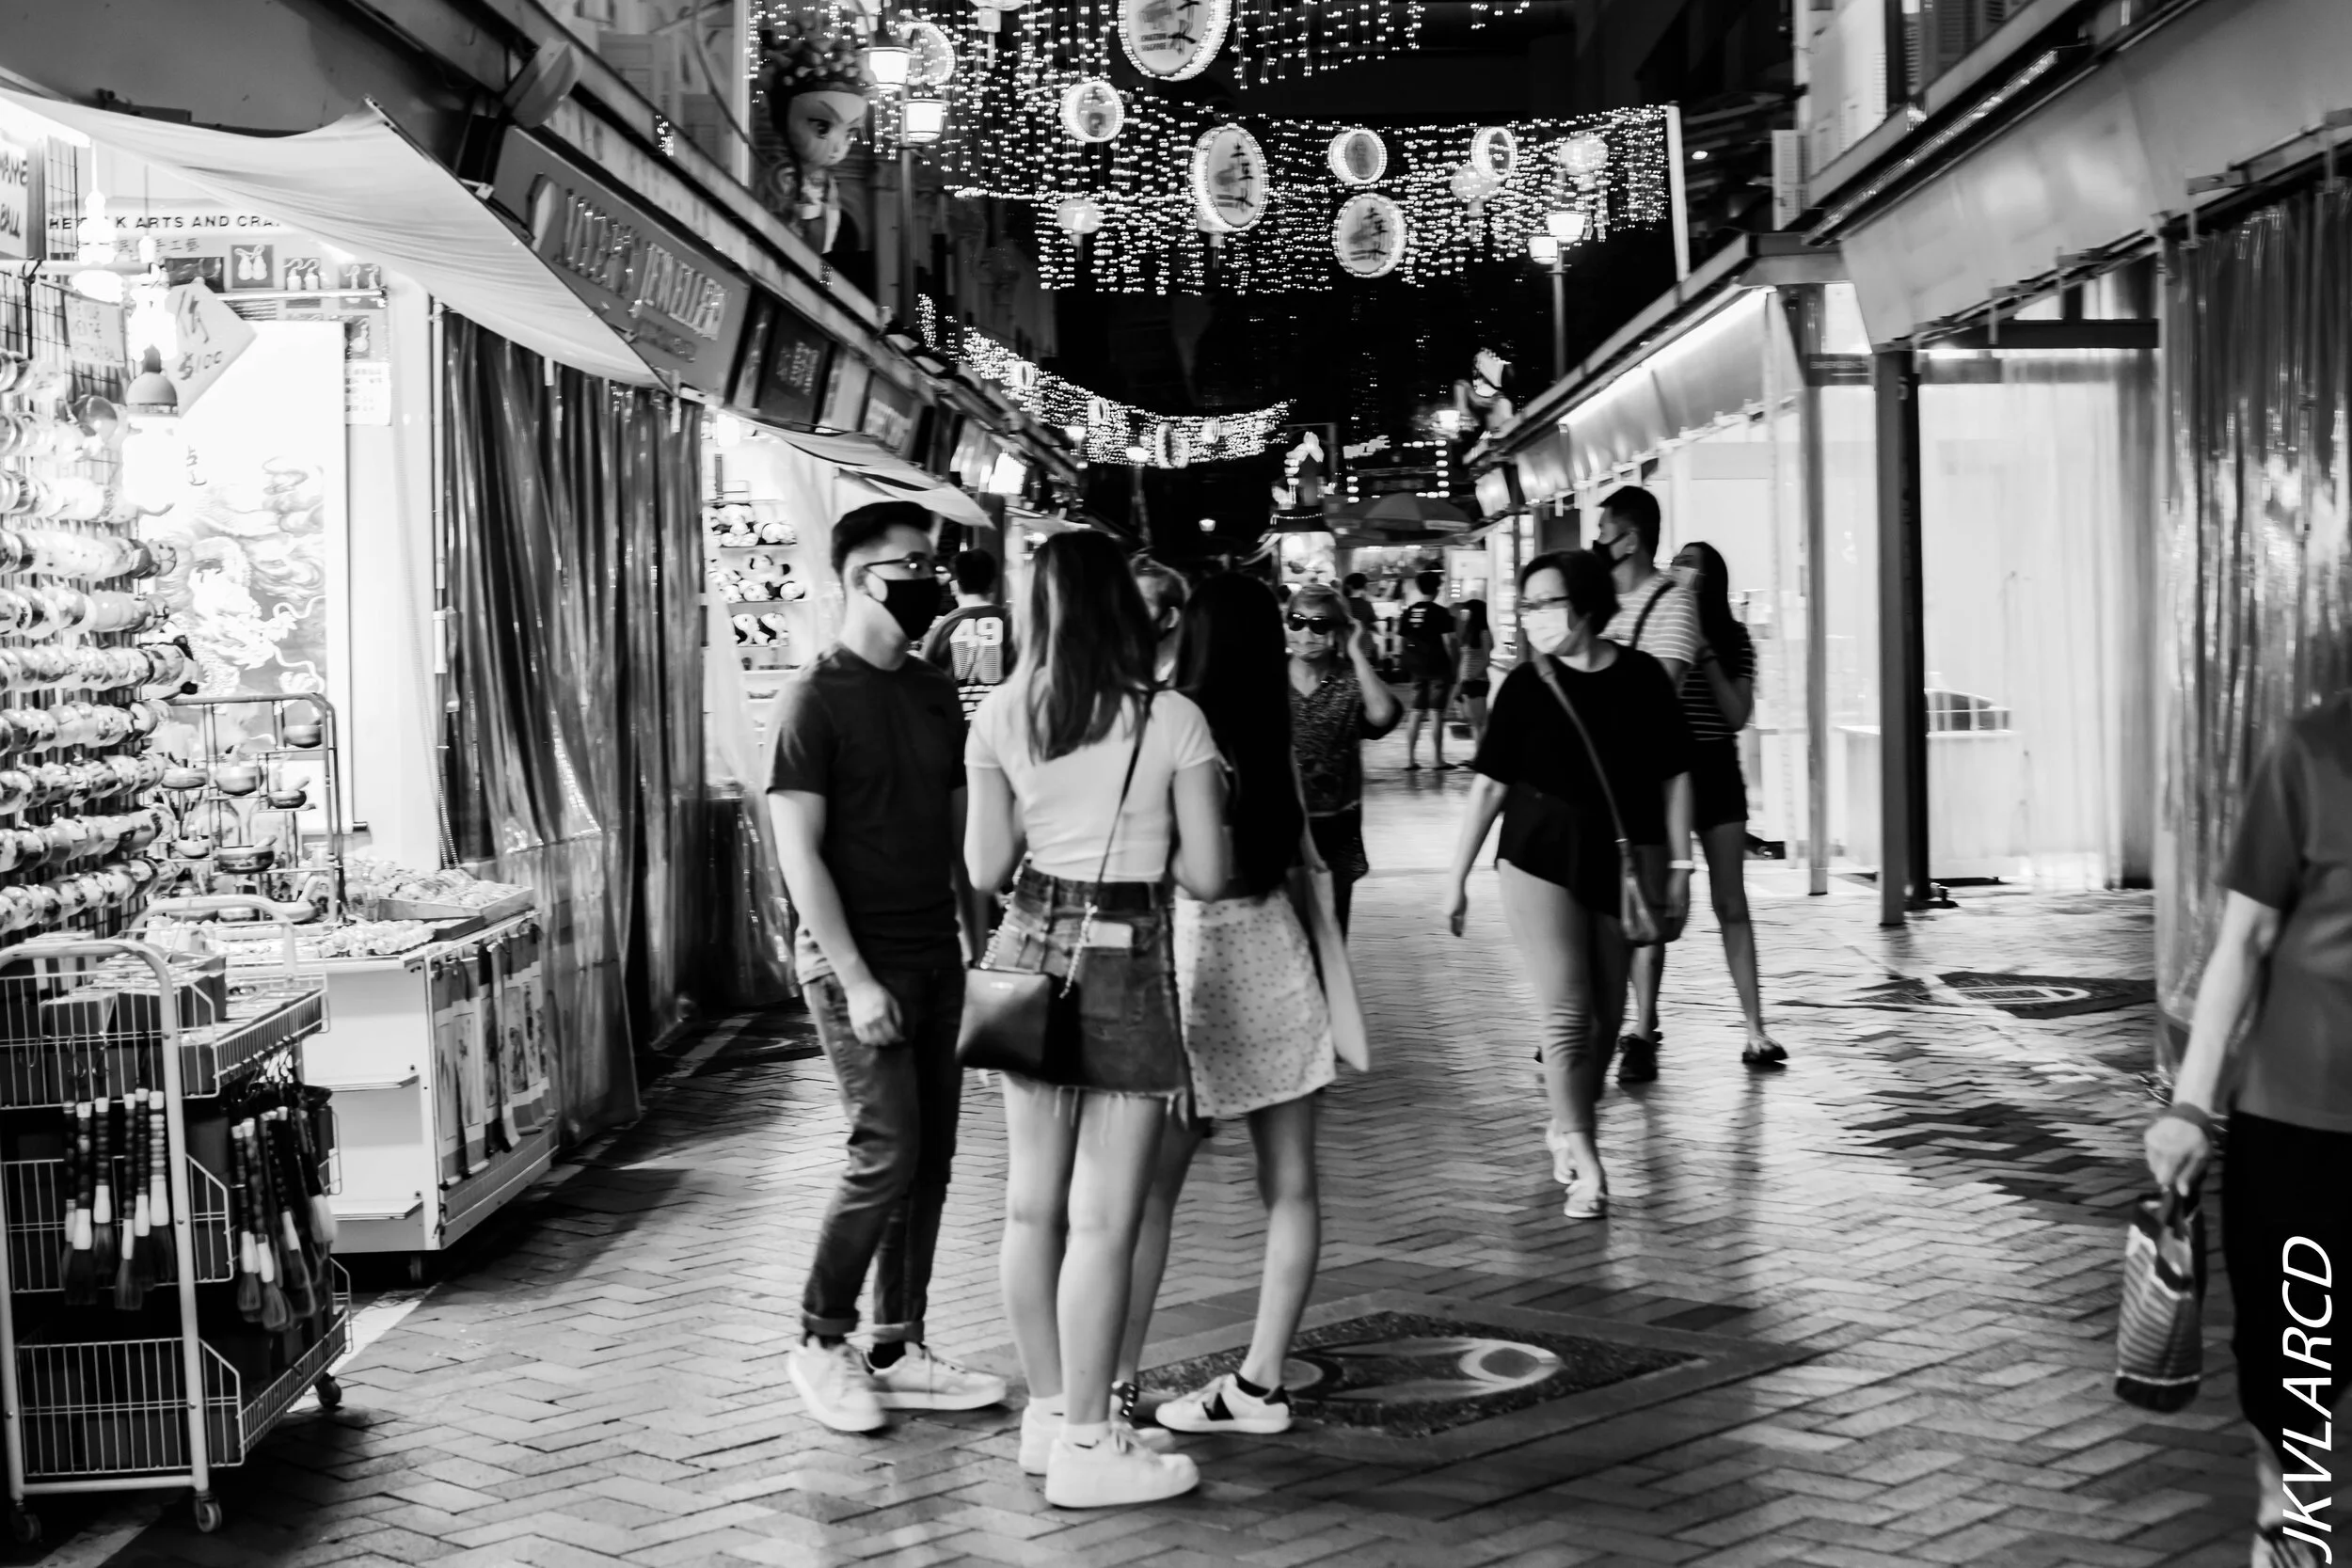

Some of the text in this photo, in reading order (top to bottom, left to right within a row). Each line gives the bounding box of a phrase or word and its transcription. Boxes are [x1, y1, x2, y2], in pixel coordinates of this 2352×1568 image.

[135, 215, 183, 228] ARTS
[191, 215, 230, 227] AND
[238, 215, 280, 228] CRA
[949, 617, 1004, 648] 49
